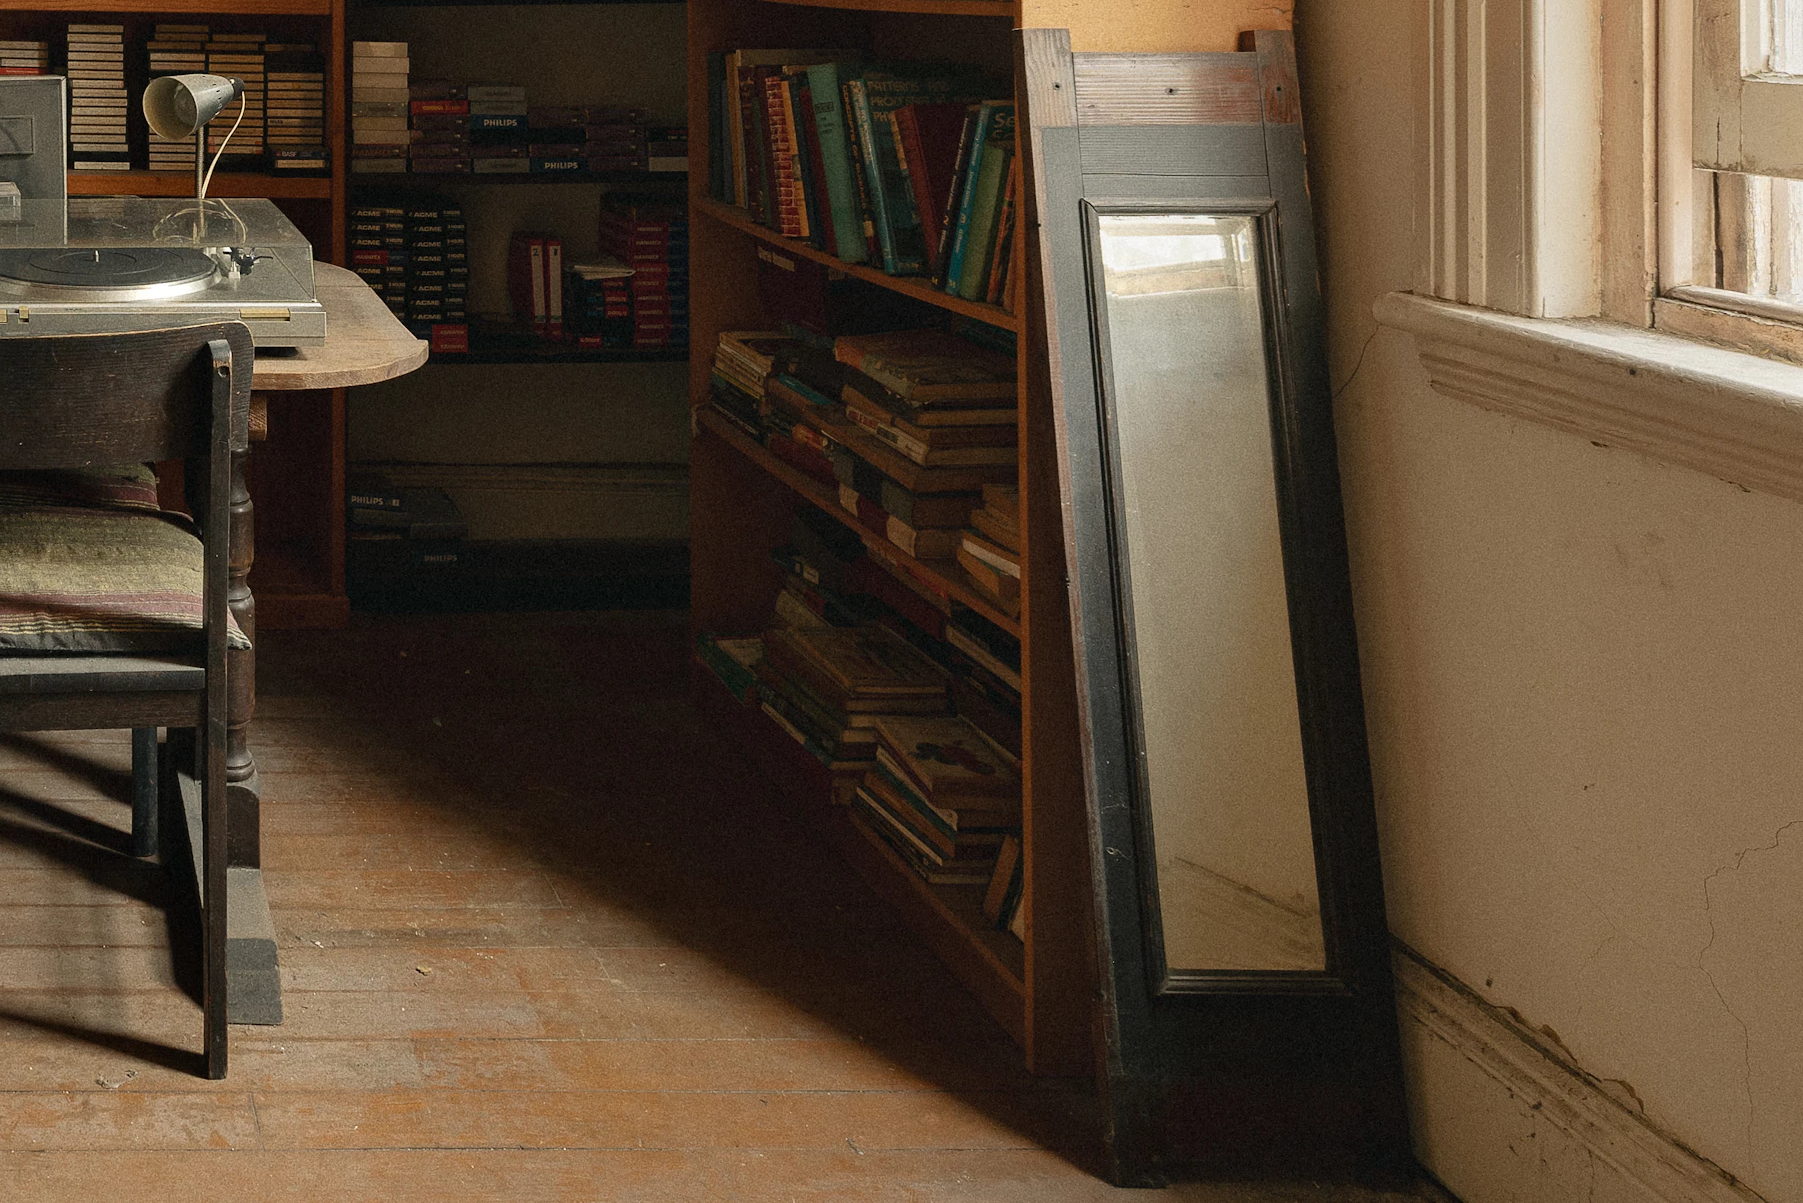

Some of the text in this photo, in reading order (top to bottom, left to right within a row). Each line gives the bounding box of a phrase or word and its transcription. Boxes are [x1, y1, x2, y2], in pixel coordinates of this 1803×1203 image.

[483, 118, 518, 127] PHILIPS
[543, 161, 579, 170] PHILIPS
[532, 248, 539, 257] 2
[350, 495, 384, 506] PHILIPS
[423, 554, 458, 563] PHILIPS
